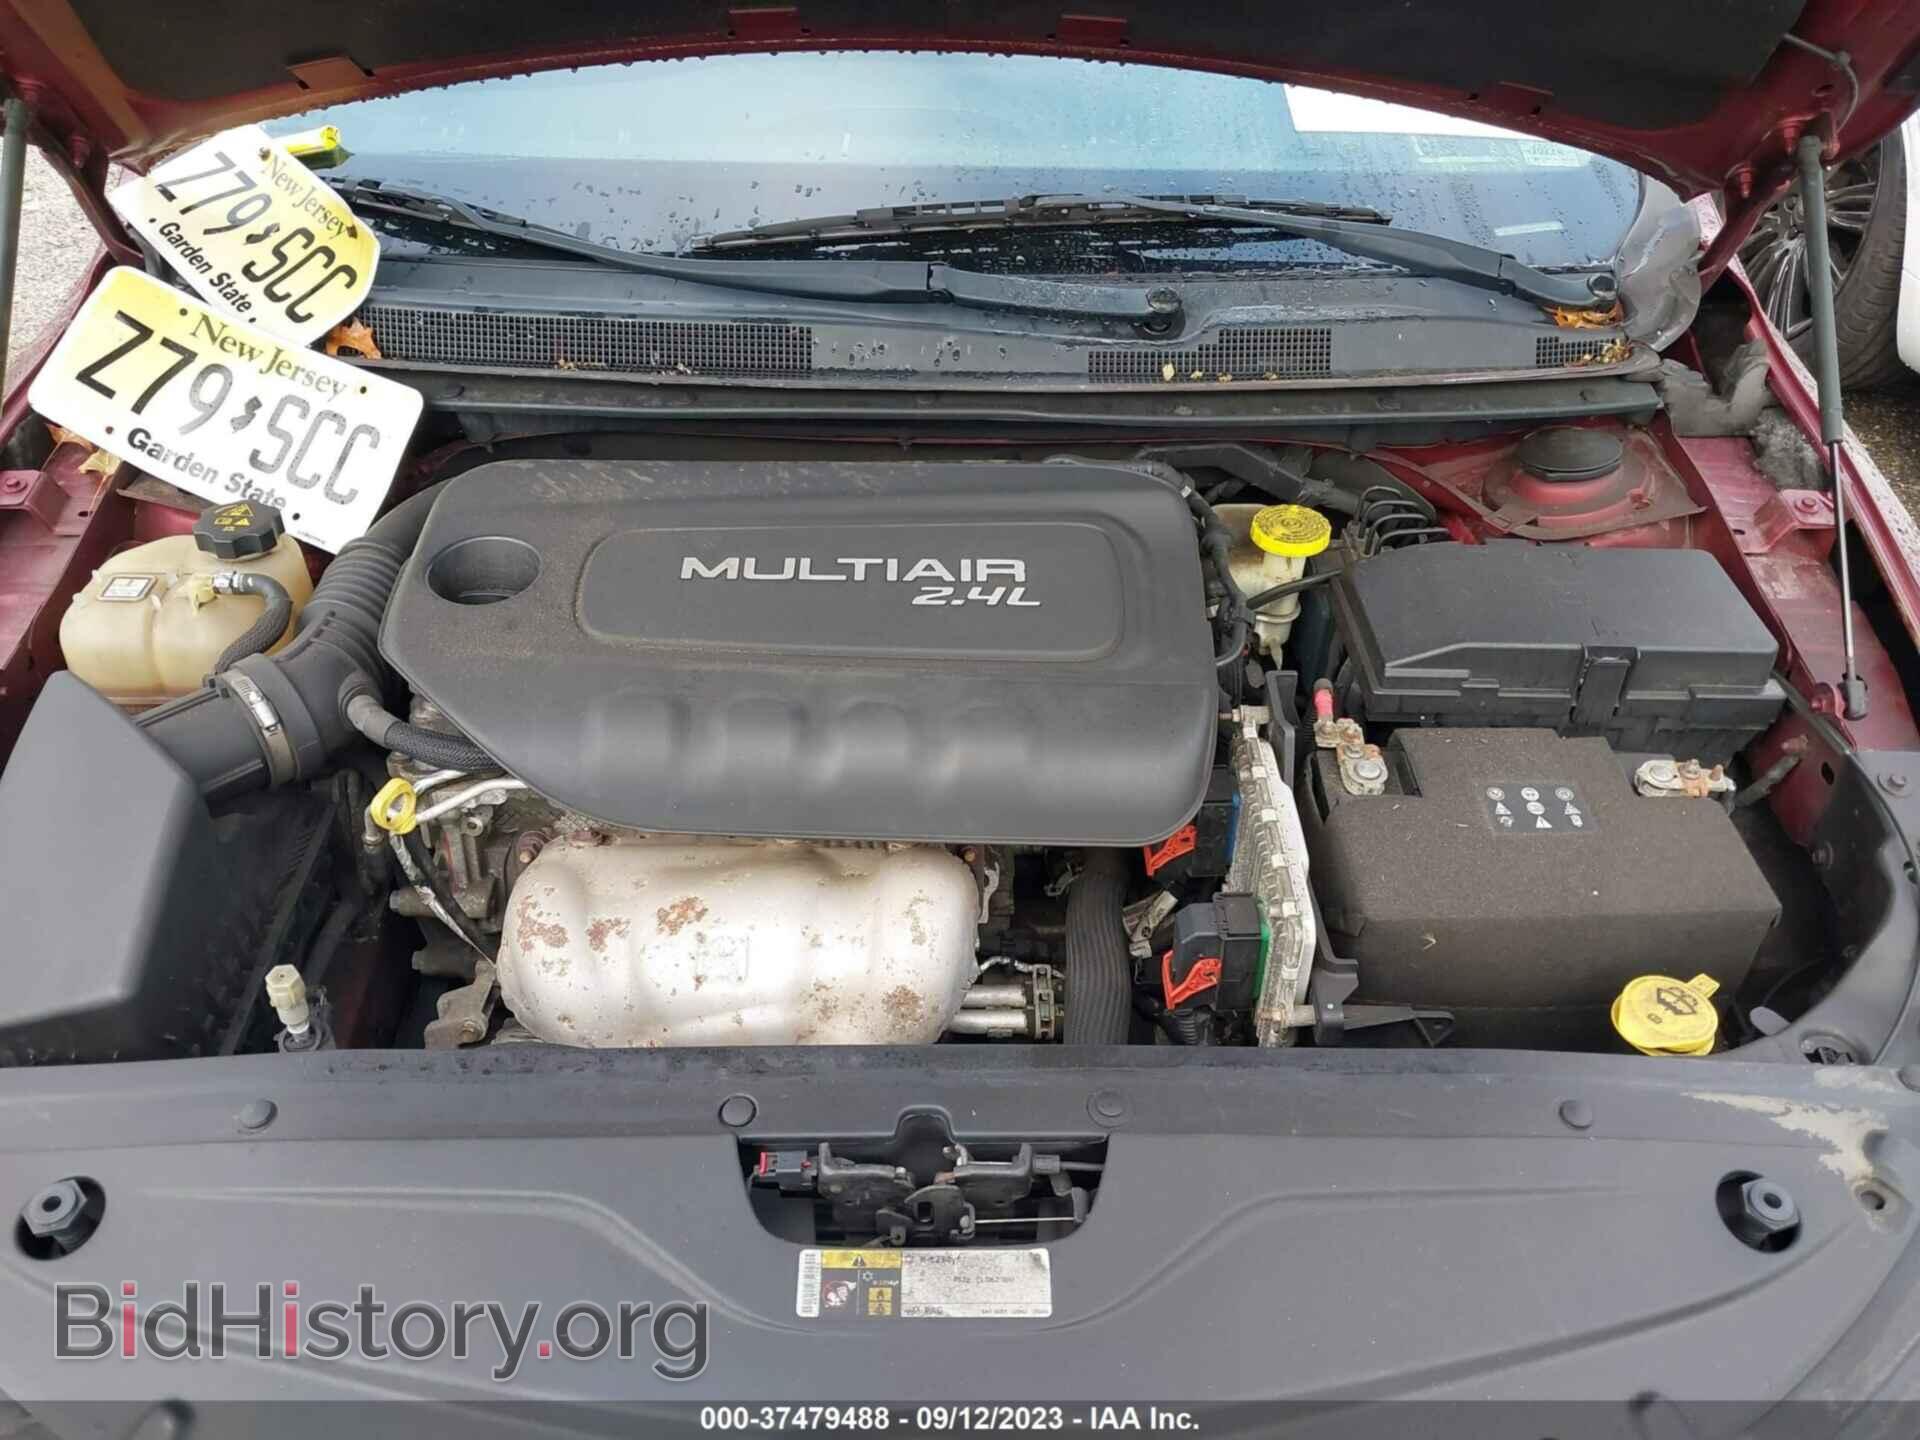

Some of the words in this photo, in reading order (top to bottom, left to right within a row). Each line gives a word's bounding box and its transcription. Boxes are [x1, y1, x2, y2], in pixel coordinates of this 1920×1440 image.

[155, 151, 272, 236] Z79
[241, 227, 358, 324] SCC
[261, 155, 304, 200] New
[293, 188, 349, 241] Jersey
[159, 222, 212, 281] Garden
[210, 272, 252, 313] State
[188, 312, 264, 362] New
[259, 346, 348, 402] Jersey
[75, 310, 233, 435] Z79
[249, 394, 380, 505] SCC
[127, 427, 219, 485] Garden
[224, 472, 286, 508] State
[680, 557, 1026, 582] MULTIAIR
[911, 586, 1041, 606] 2.4L
